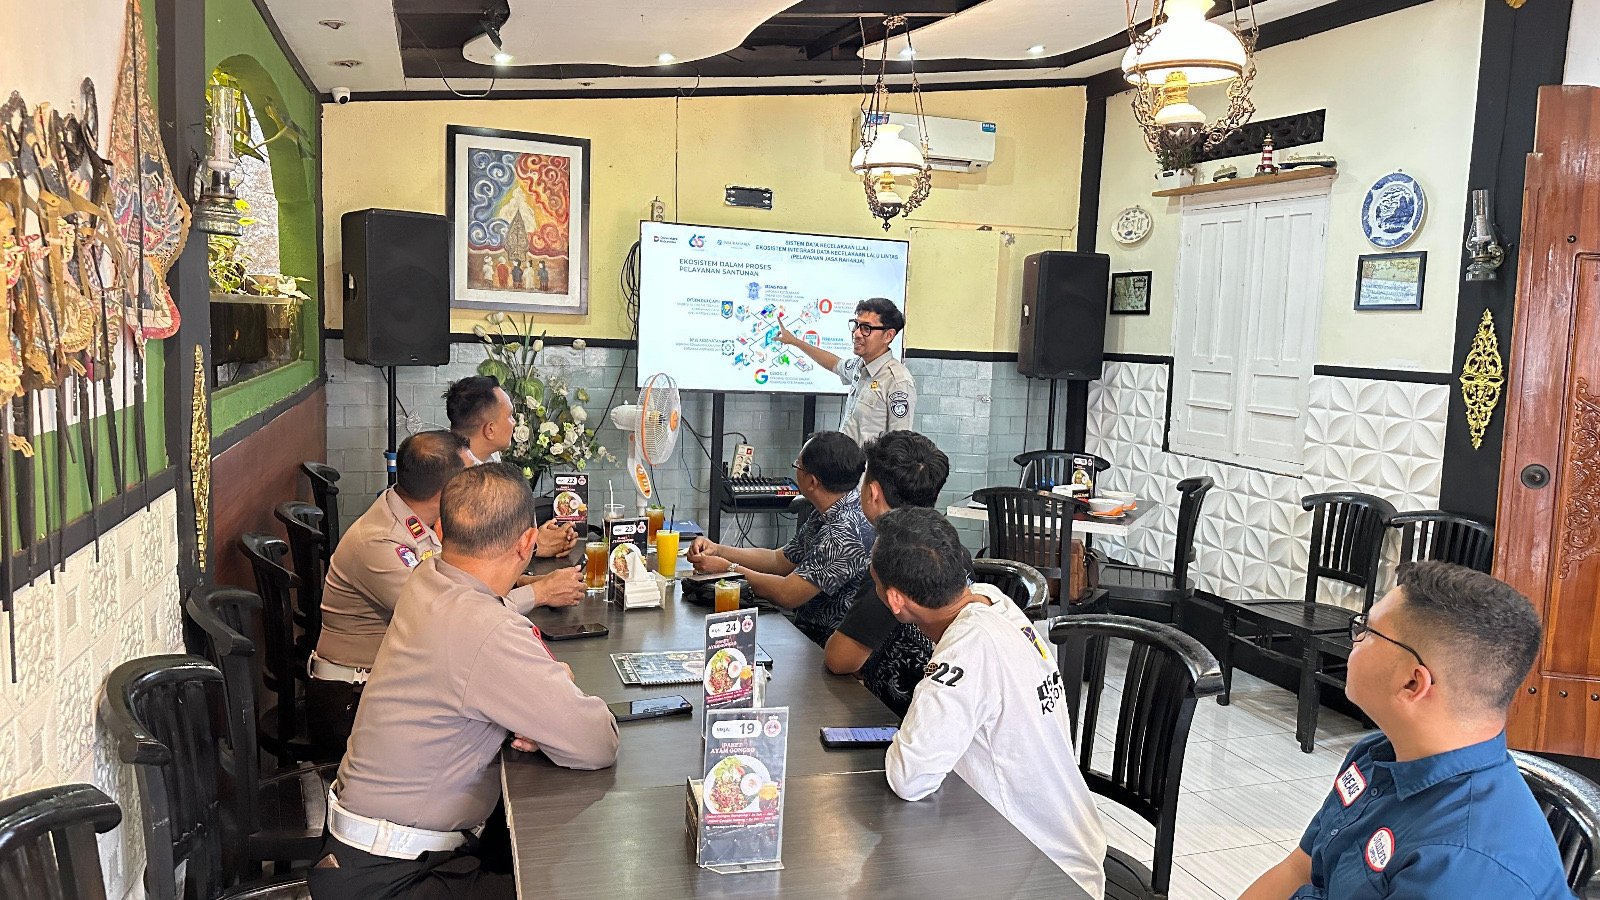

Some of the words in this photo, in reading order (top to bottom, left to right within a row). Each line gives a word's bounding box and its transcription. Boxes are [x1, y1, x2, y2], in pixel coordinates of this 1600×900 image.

[680, 266, 720, 274] PELAYANAN
[726, 623, 736, 632] 24
[740, 723, 755, 734] 19
